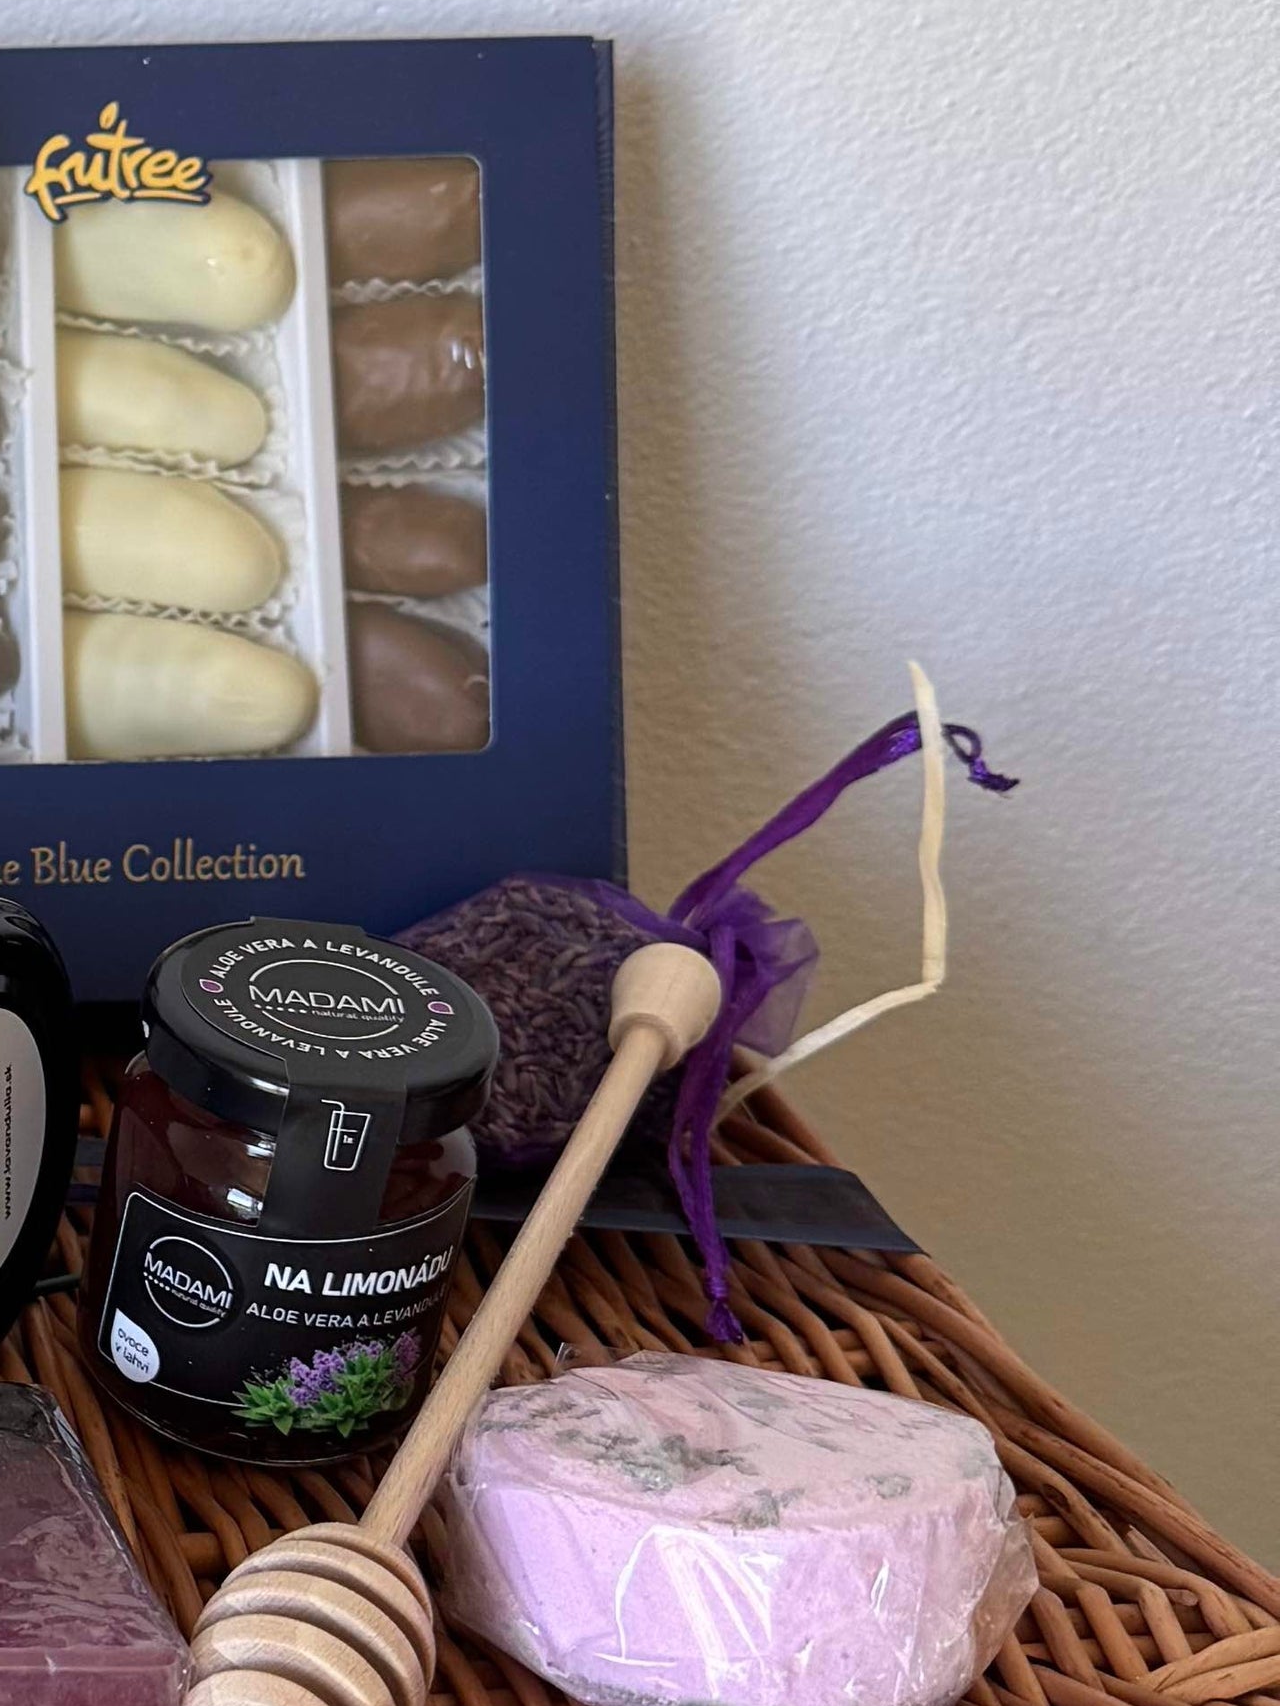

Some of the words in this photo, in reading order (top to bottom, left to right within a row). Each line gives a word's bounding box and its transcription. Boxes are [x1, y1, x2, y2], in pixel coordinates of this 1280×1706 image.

[25, 118, 206, 220] frutree
[30, 840, 112, 885] Blue
[122, 836, 306, 883] Collection
[209, 949, 245, 979] ALOE
[238, 937, 297, 956] VERA
[303, 938, 319, 950] A
[326, 940, 441, 998] LEVANDULE
[248, 983, 406, 1015] MADAMI
[212, 997, 326, 1057] LEVANDULE
[411, 1017, 448, 1049] ALOE
[334, 1049, 351, 1060] A
[357, 1042, 419, 1061] VERA
[143, 1251, 234, 1310] MADAMI
[262, 1261, 313, 1295] NA
[321, 1243, 455, 1298] LIMONÁDU
[244, 1301, 301, 1326] ALOE
[302, 1311, 356, 1329] VERA
[355, 1313, 371, 1328] A
[117, 1327, 150, 1358] ovoce
